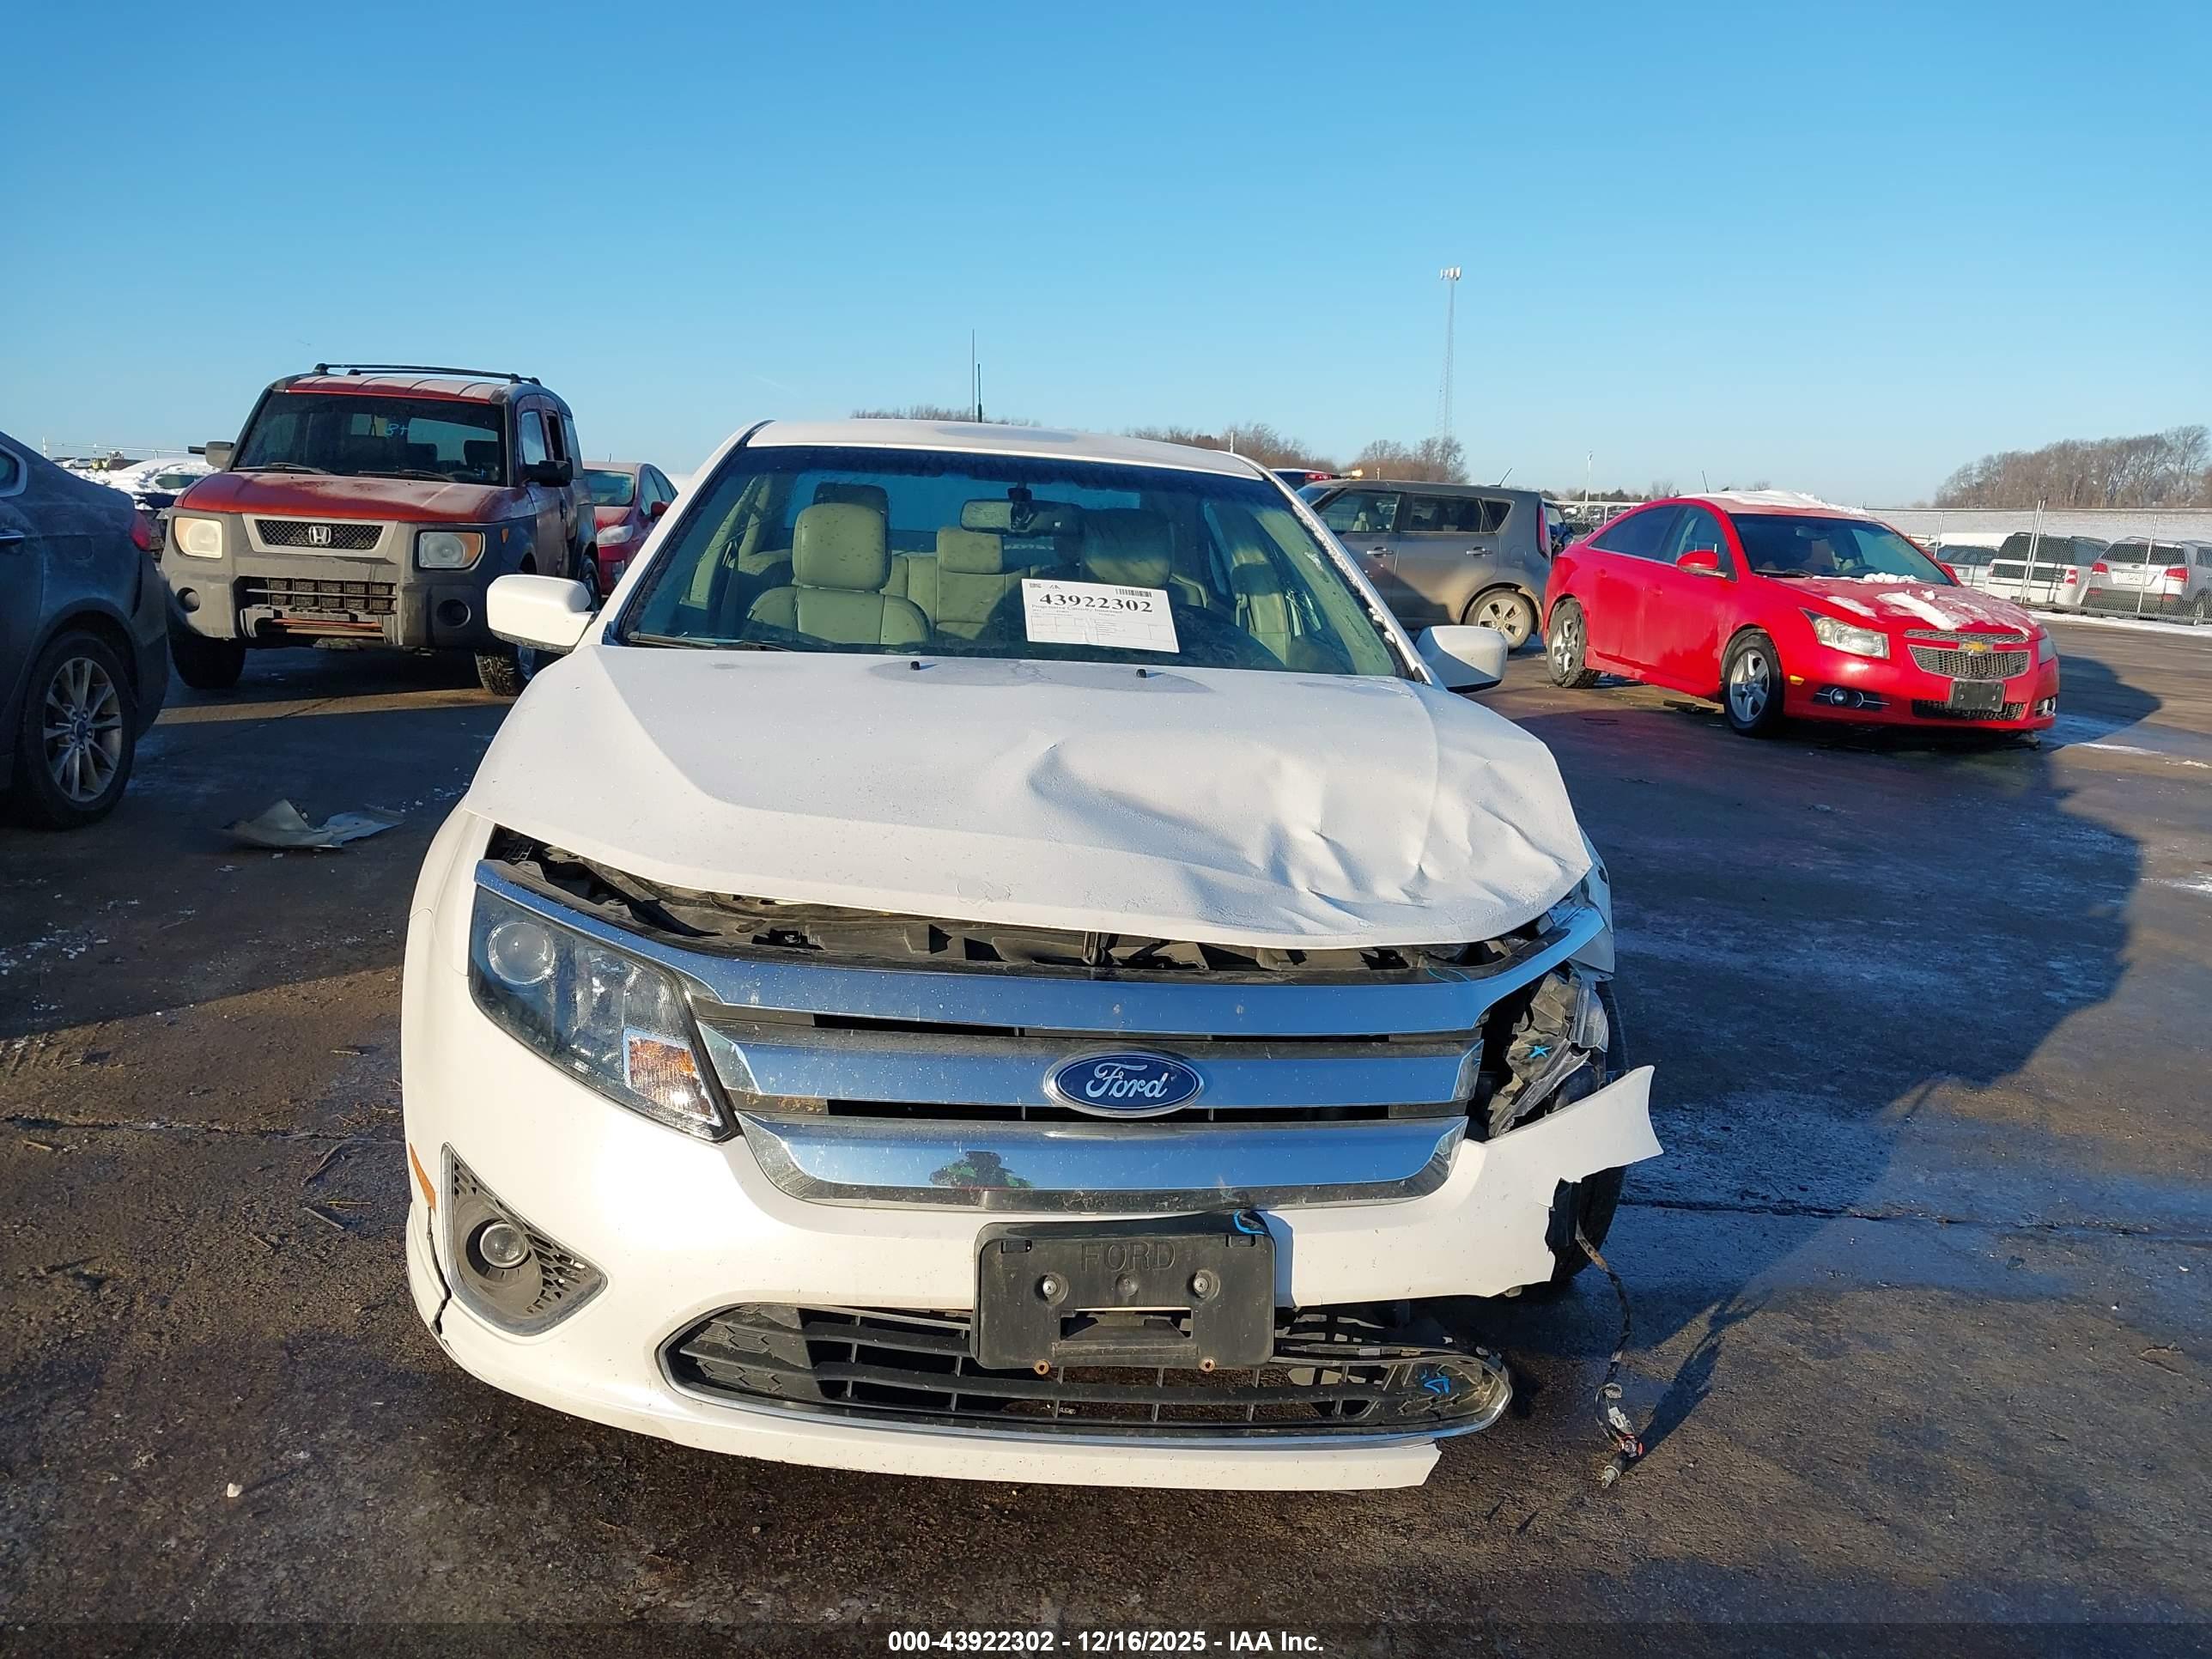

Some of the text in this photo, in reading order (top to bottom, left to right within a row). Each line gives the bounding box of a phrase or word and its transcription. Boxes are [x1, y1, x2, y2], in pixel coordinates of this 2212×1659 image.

[1039, 593, 1153, 612] 43922302
[1085, 1062, 1169, 1097] Ford
[1081, 1241, 1176, 1272] FORD
